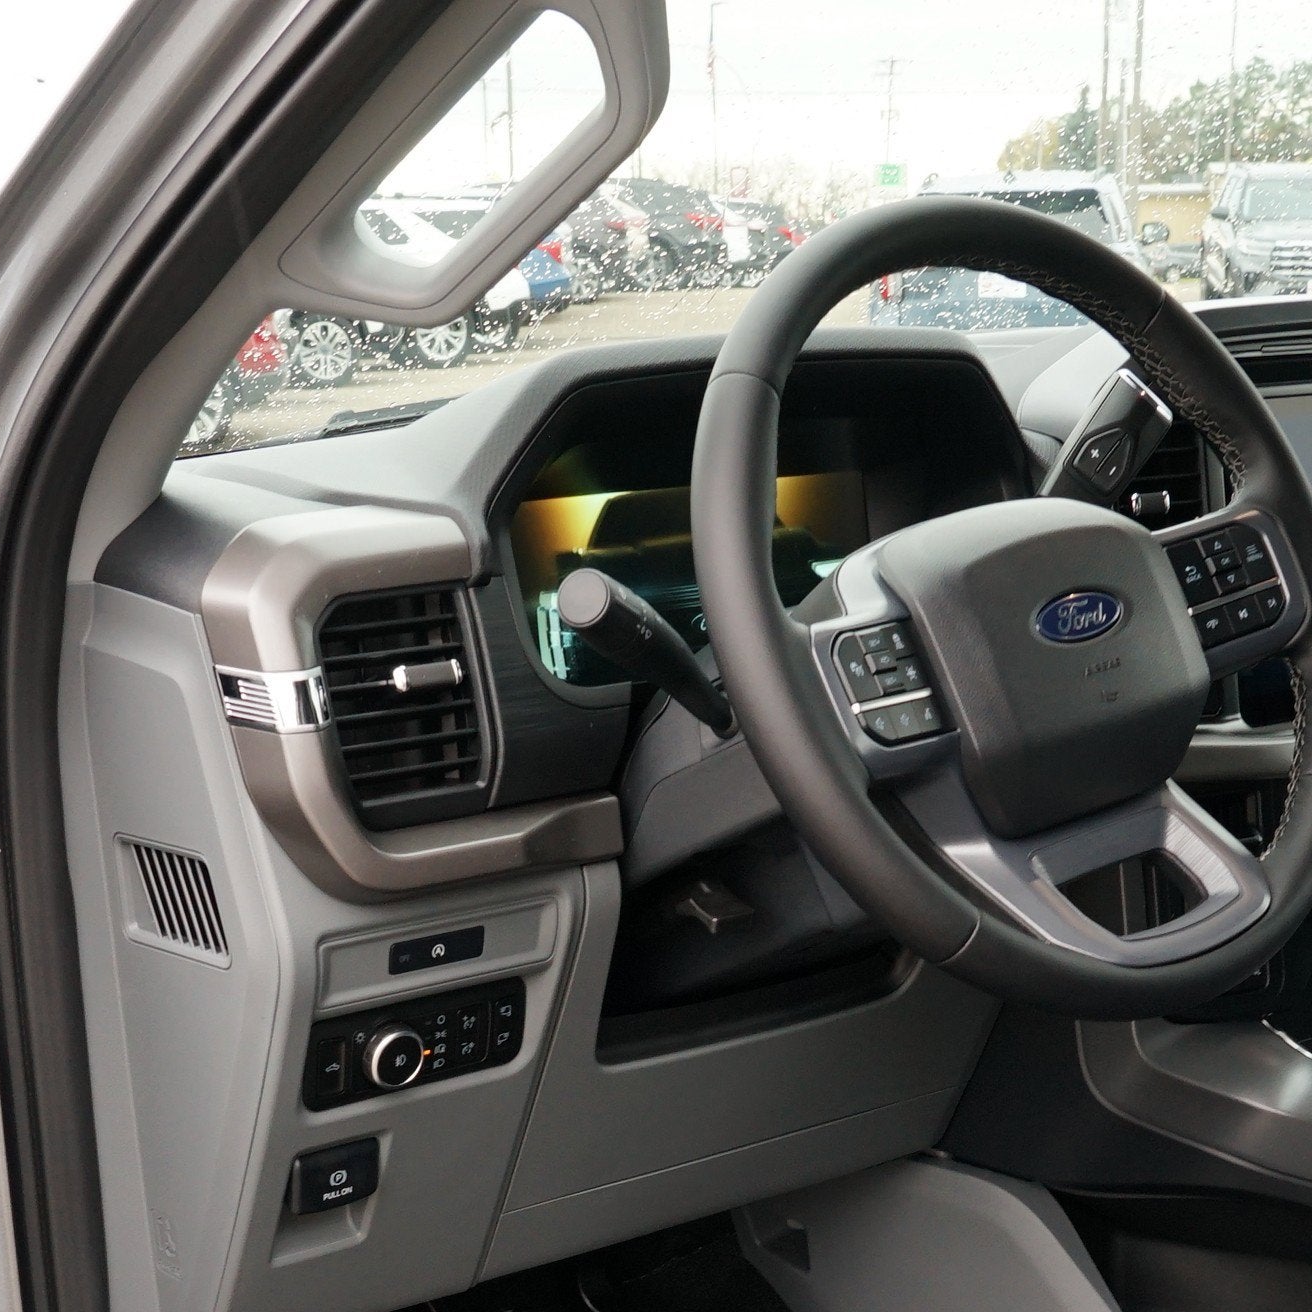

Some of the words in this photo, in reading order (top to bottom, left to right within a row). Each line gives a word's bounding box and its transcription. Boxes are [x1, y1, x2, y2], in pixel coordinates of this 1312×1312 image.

[1057, 598, 1107, 635] Ford
[323, 1190, 341, 1201] PULL
[341, 1186, 353, 1196] ON
